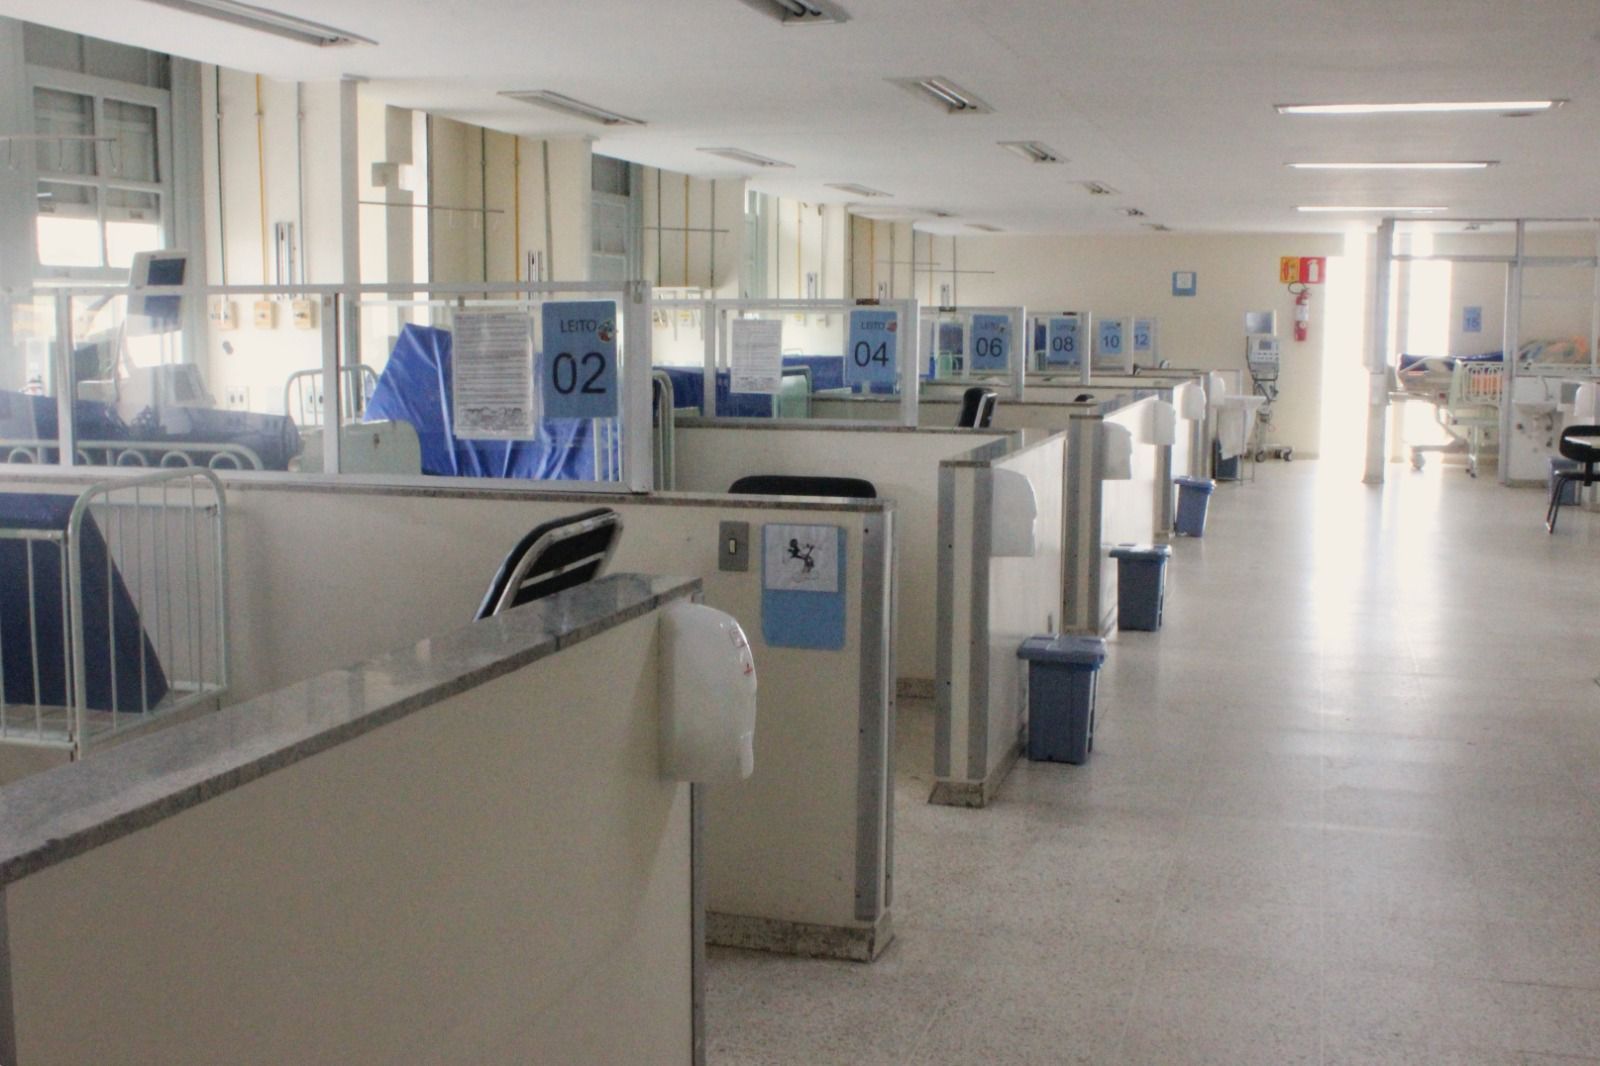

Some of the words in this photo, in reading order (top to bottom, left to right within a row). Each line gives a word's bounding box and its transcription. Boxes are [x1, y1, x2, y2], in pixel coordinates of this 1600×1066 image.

[560, 319, 597, 333] LEITO
[976, 337, 1002, 357] 06
[1052, 336, 1074, 352] 08
[1103, 335, 1121, 349] 10
[1134, 333, 1149, 346] 12
[854, 340, 890, 368] 04
[552, 351, 606, 395] 02
